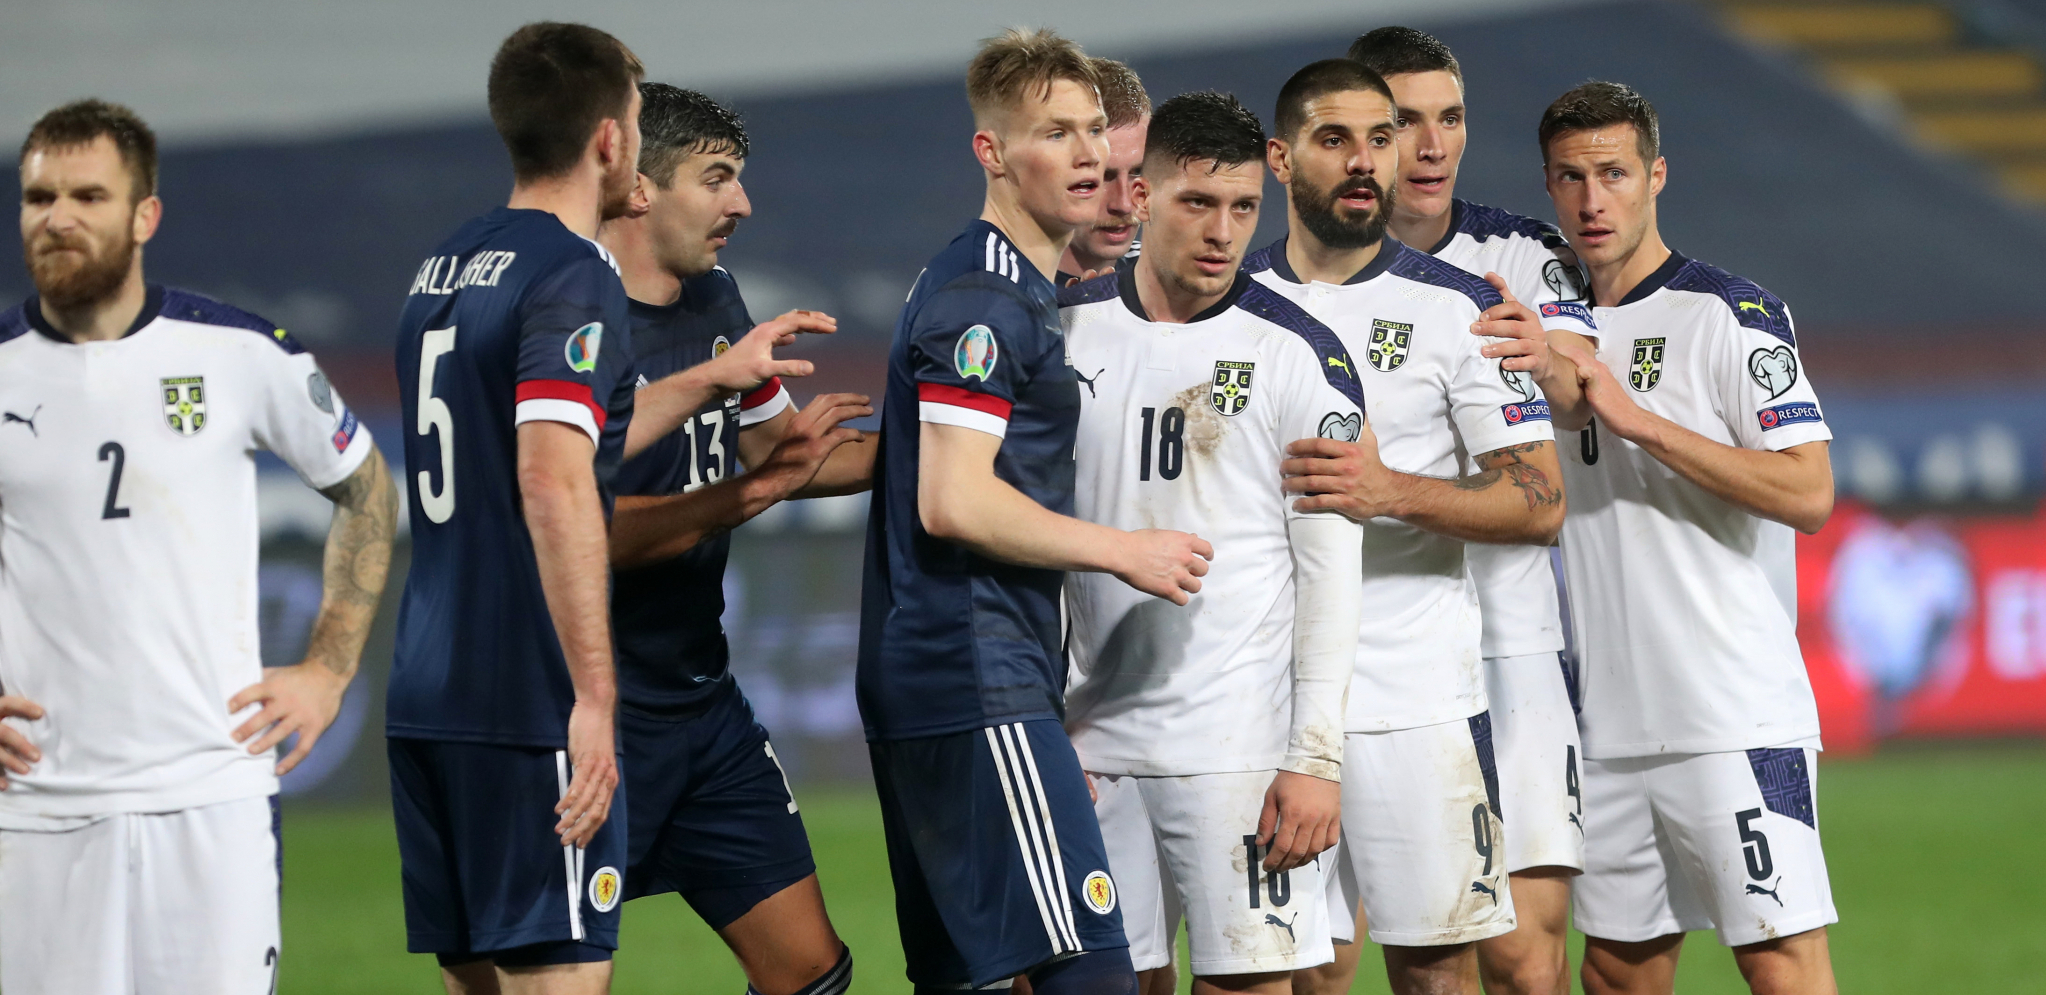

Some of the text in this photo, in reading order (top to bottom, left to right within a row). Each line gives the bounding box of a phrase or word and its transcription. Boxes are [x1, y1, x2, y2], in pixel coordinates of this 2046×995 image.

[409, 250, 516, 296] GALLGHER
[418, 325, 457, 524] 5
[684, 409, 725, 493] 13
[1140, 406, 1185, 481] 18
[1778, 407, 1818, 420] RESPECT
[98, 440, 130, 520] 2
[1566, 744, 1582, 816] 4
[1472, 802, 1493, 877] 9
[1735, 807, 1774, 882] 5
